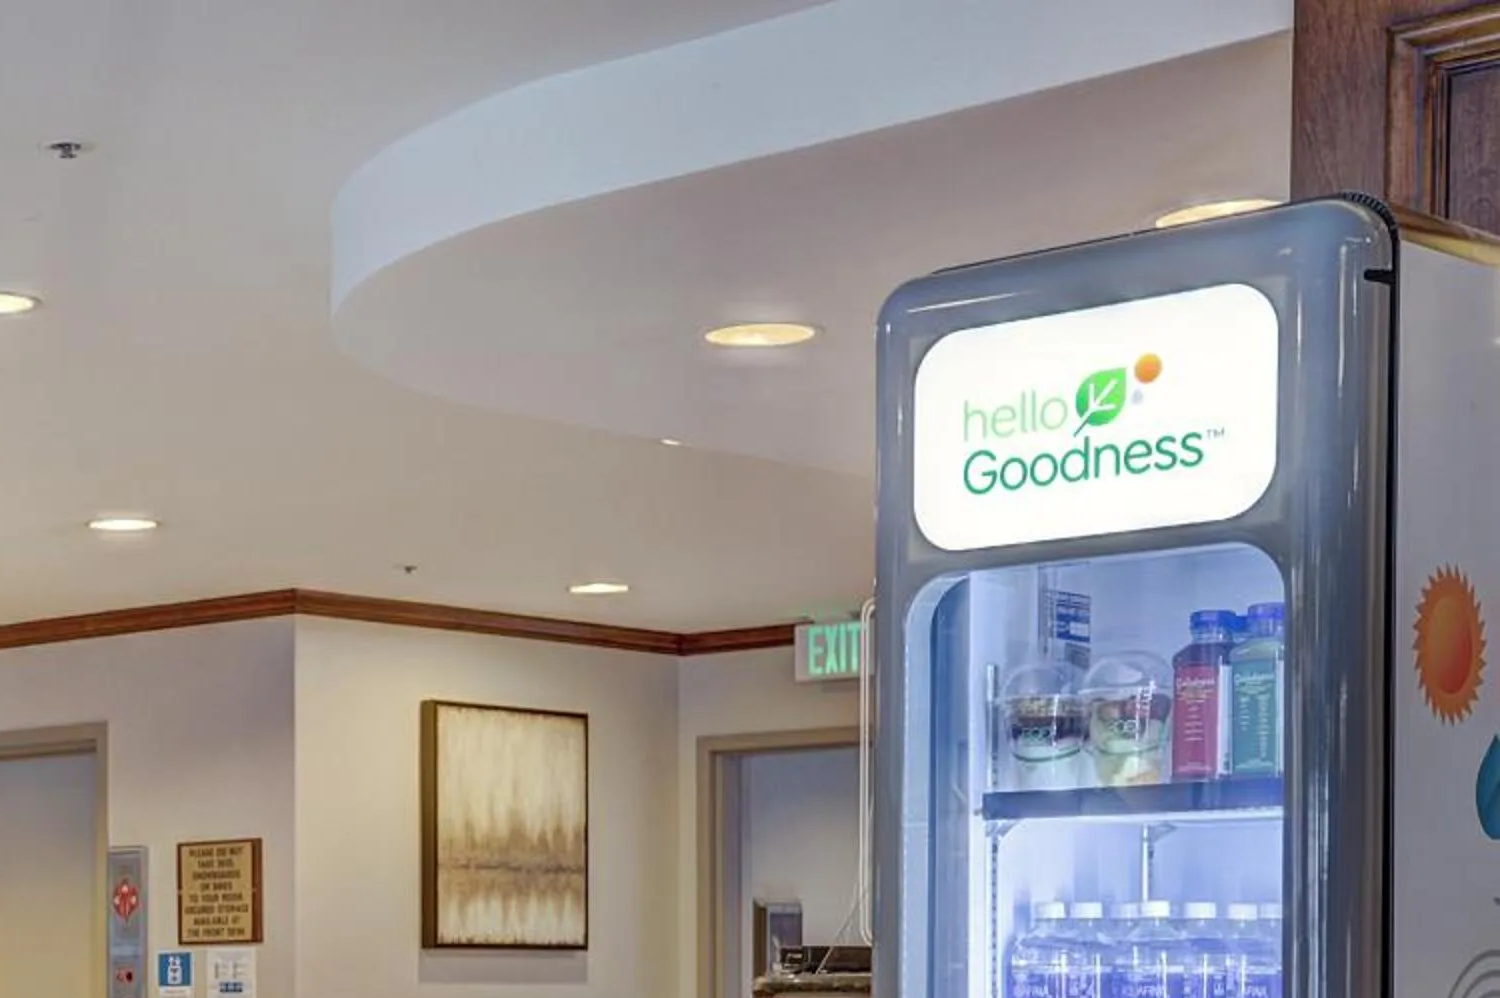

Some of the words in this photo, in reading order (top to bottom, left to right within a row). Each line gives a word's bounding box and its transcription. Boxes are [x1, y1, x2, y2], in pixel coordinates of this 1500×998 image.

[963, 390, 1068, 442] hello
[963, 430, 1206, 495] Goodness
[808, 621, 866, 675] EXIT
